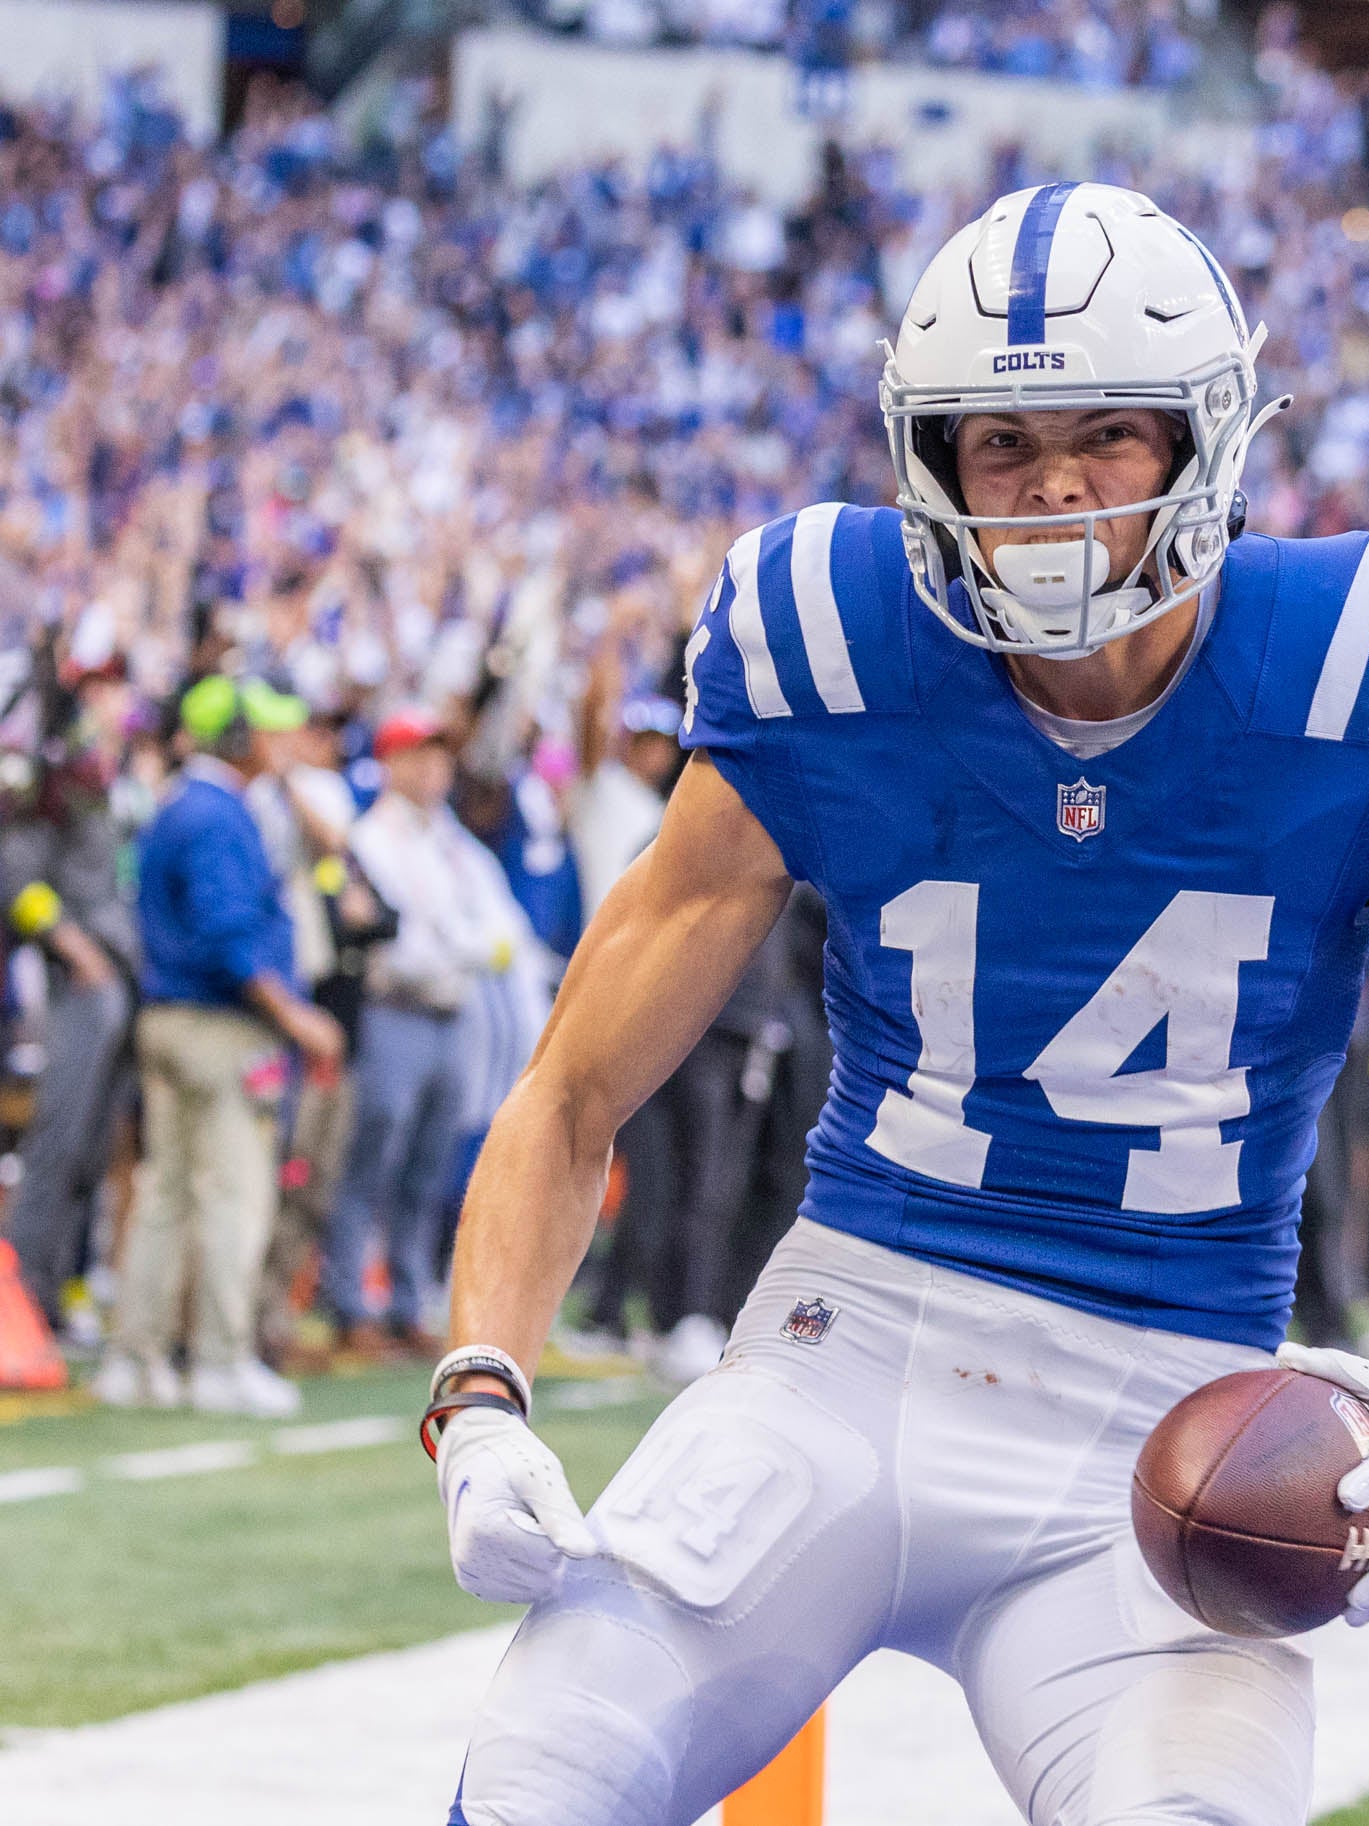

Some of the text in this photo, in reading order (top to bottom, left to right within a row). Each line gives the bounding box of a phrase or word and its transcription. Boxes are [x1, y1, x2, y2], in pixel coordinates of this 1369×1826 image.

[993, 352, 1065, 374] COLTS
[1063, 806, 1097, 830] NFL
[864, 880, 1276, 1215] 14
[608, 1428, 782, 1561] 14
